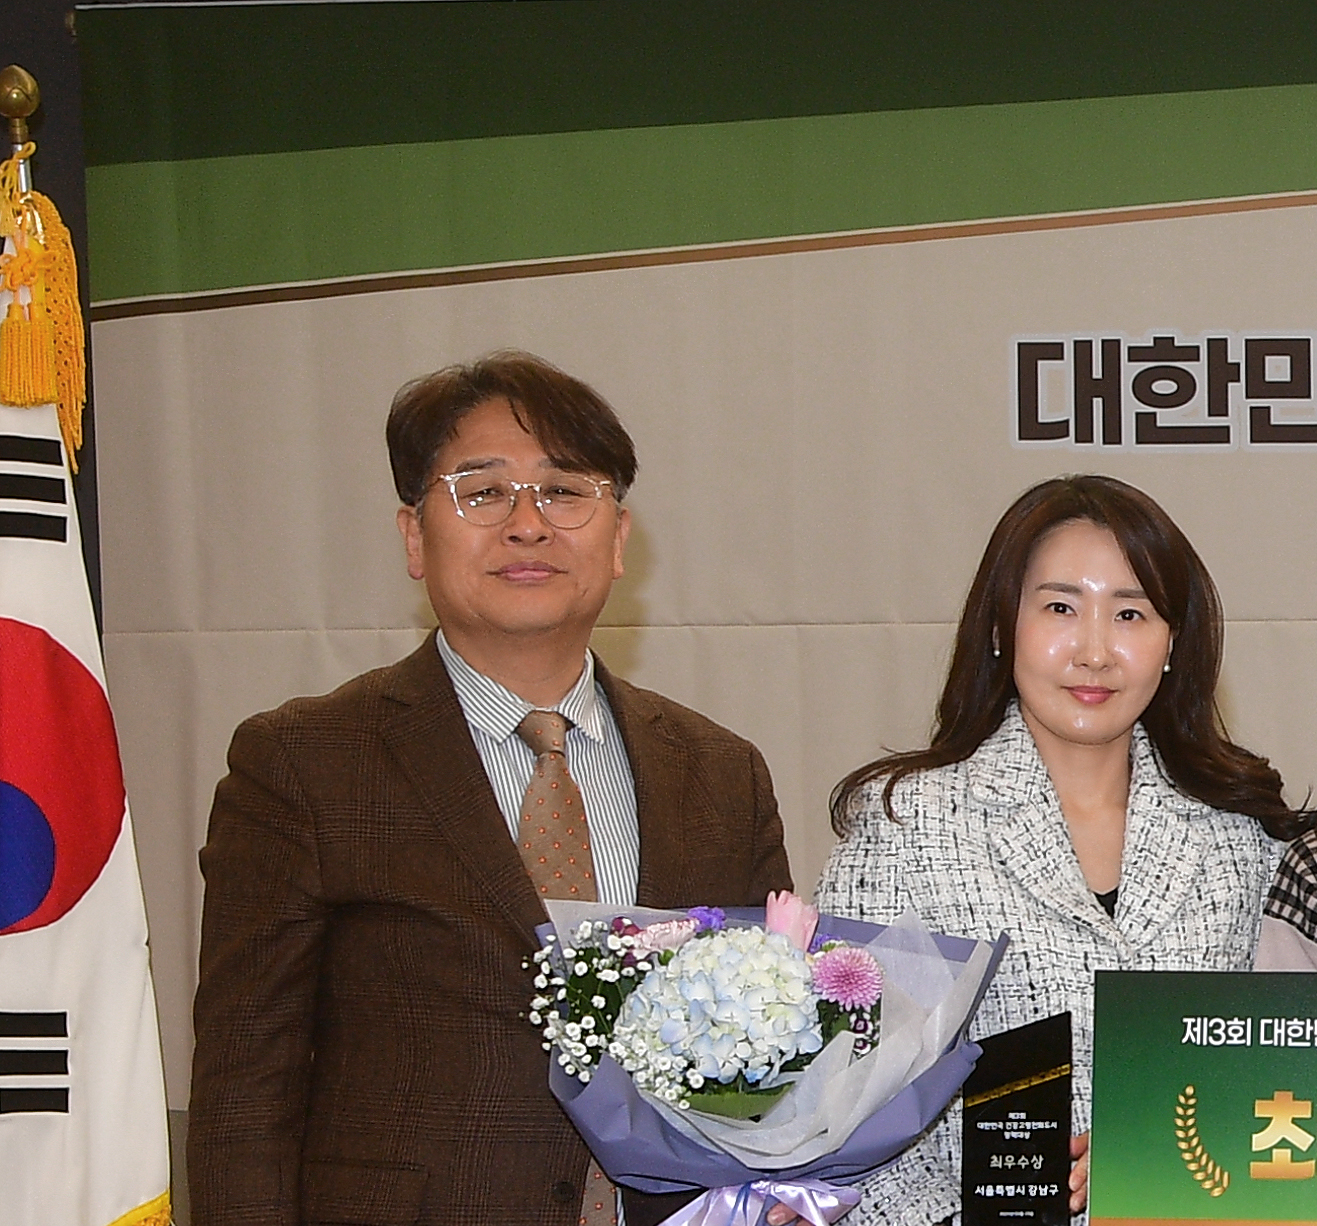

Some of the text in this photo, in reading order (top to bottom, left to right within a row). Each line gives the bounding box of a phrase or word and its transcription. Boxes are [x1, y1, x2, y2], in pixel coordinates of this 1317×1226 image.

[1181, 1016, 1251, 1047] 제3회
[990, 1154, 1044, 1170] 최우수상
[975, 1184, 1059, 1197] 서울특별시 강남구
